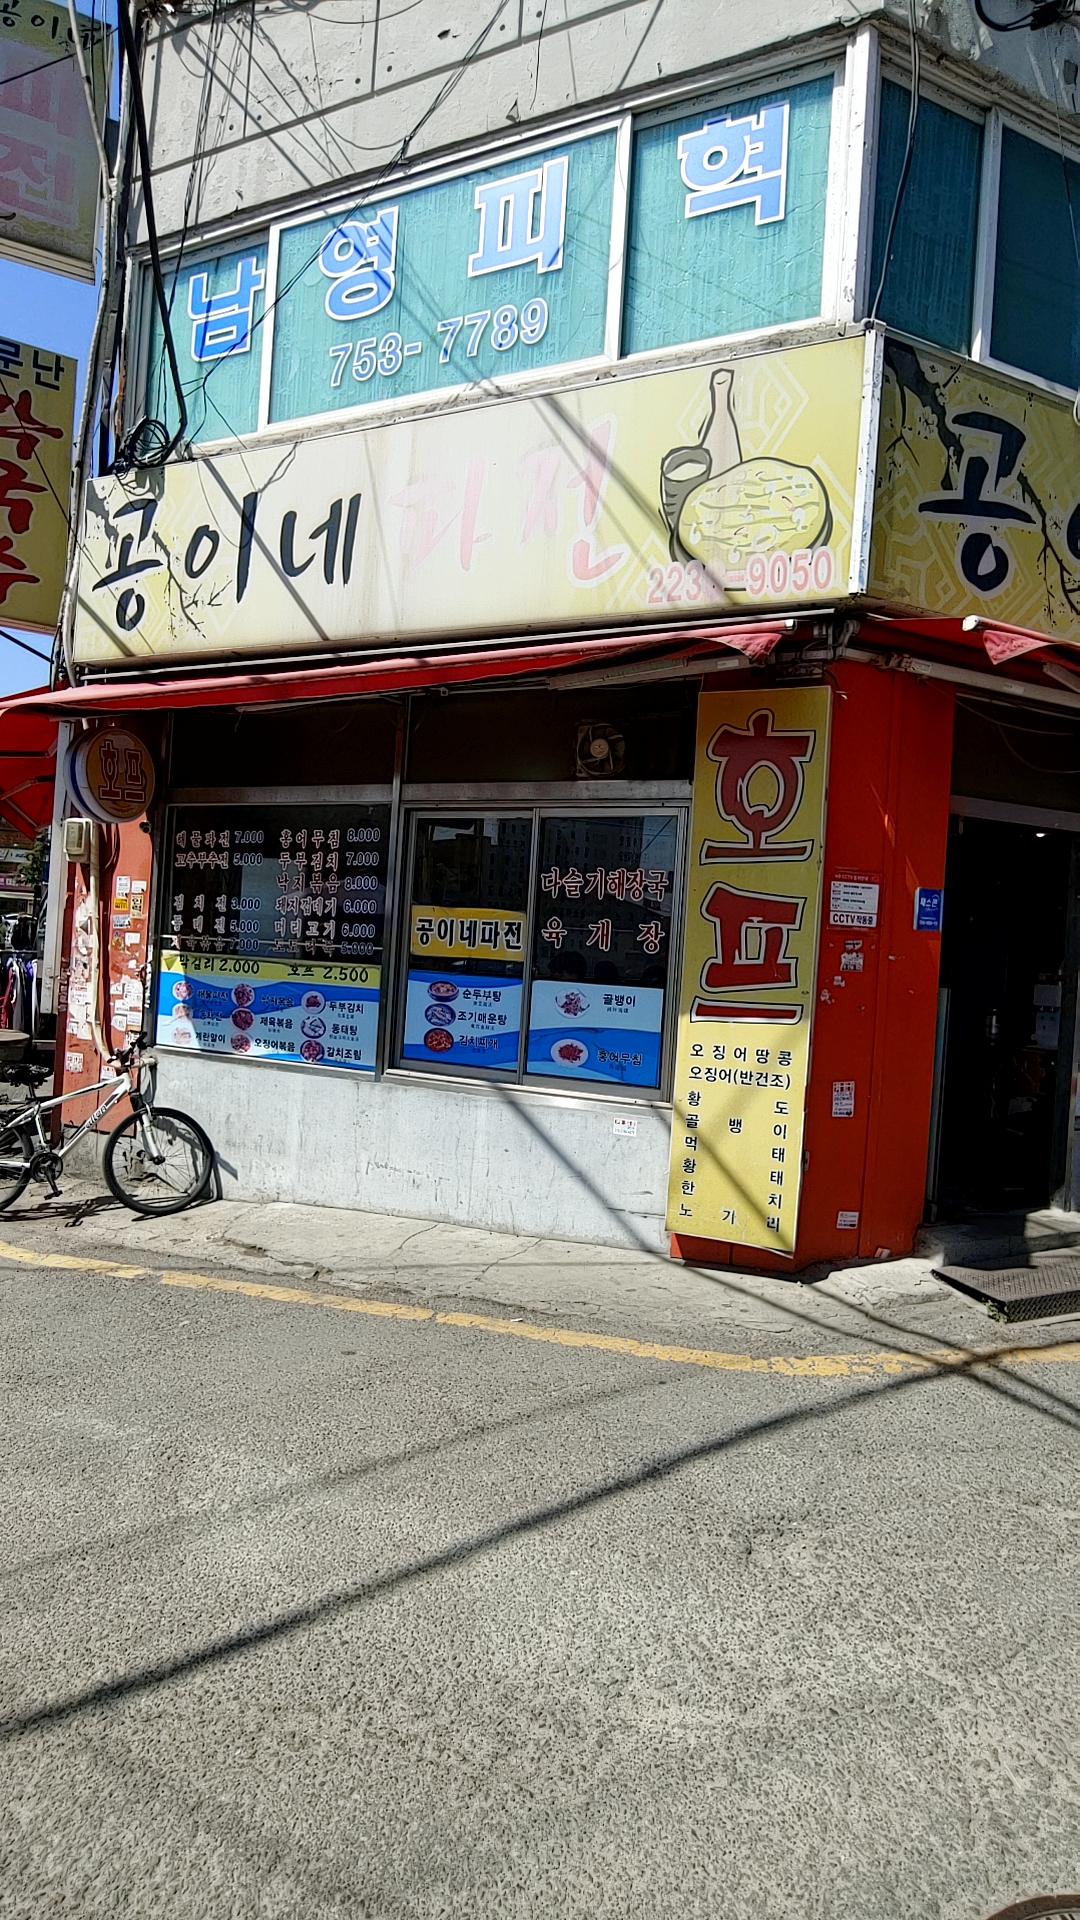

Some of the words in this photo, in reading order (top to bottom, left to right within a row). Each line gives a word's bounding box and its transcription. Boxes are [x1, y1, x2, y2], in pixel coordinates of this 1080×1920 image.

[919, 411, 1080, 592] 공
[92, 491, 362, 632] 공이네
[390, 414, 631, 583] 파전
[648, 551, 832, 604] 223-9050
[98, 739, 147, 803] 호프
[234, 831, 264, 843] 7.000
[280, 829, 340, 849] 홍어무침
[347, 828, 380, 842] 8.000
[175, 851, 228, 869] 고추부추전
[233, 853, 263, 865] 5.000
[278, 852, 339, 872] 두부김치
[345, 852, 379, 866] 7.000
[690, 708, 816, 1024] 호프
[276, 872, 340, 894] 낙지볶음
[344, 876, 378, 891] 8.000
[541, 866, 669, 901] 다슬기해장국
[343, 899, 377, 914] 6.000
[230, 920, 260, 933] 5.000
[274, 917, 336, 940] 머리고기
[341, 923, 375, 938] 6.000
[416, 918, 523, 950] 공이네파전
[541, 916, 666, 954] 육개장
[219, 958, 260, 974] 2.000
[287, 963, 315, 977] 호프
[323, 966, 369, 983] 2.500
[462, 988, 502, 1003] 순두부탕
[603, 993, 637, 1008] 골뱅이
[329, 1001, 364, 1014] 두부김치
[260, 1016, 293, 1029] 제육볶음
[457, 1011, 507, 1026] 조기매운탕
[196, 1031, 226, 1044] 계란말이
[331, 1023, 358, 1036] 동태탕
[254, 1038, 296, 1053] 오징어볶음
[459, 1035, 498, 1049] 김치찌개
[327, 1046, 362, 1060] 갈치조림
[689, 1066, 791, 1090] 오징어(반건조)
